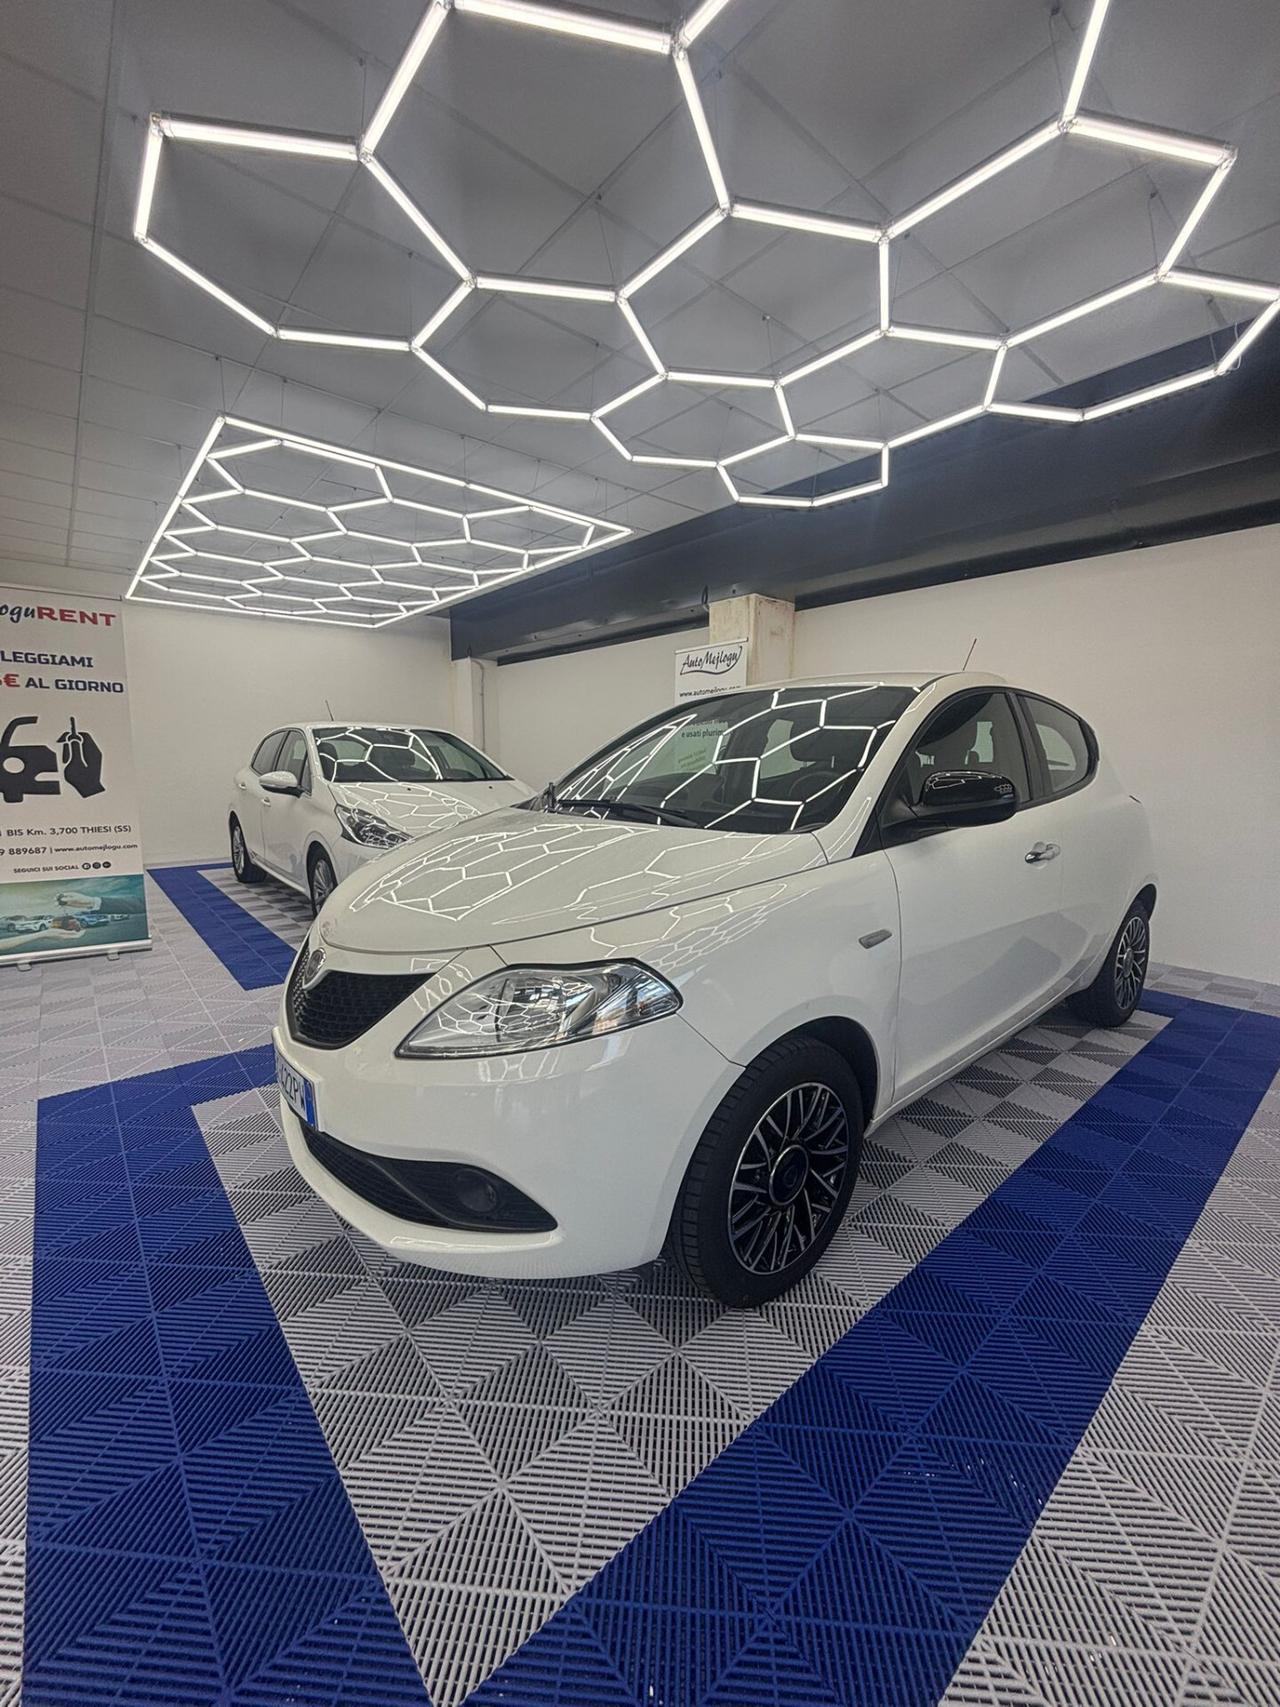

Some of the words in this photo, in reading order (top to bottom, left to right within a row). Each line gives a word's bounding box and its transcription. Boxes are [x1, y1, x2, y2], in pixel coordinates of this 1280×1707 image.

[0, 650, 94, 668] LEGGIAMI
[25, 677, 50, 689] AL
[55, 678, 124, 693] GIORNO
[27, 828, 47, 836] Km.
[50, 827, 78, 836] 3,700
[80, 825, 112, 834] THIESI
[114, 825, 132, 833] (SS)
[9, 847, 47, 855] 889687
[54, 844, 138, 852] www.automejlogu.com
